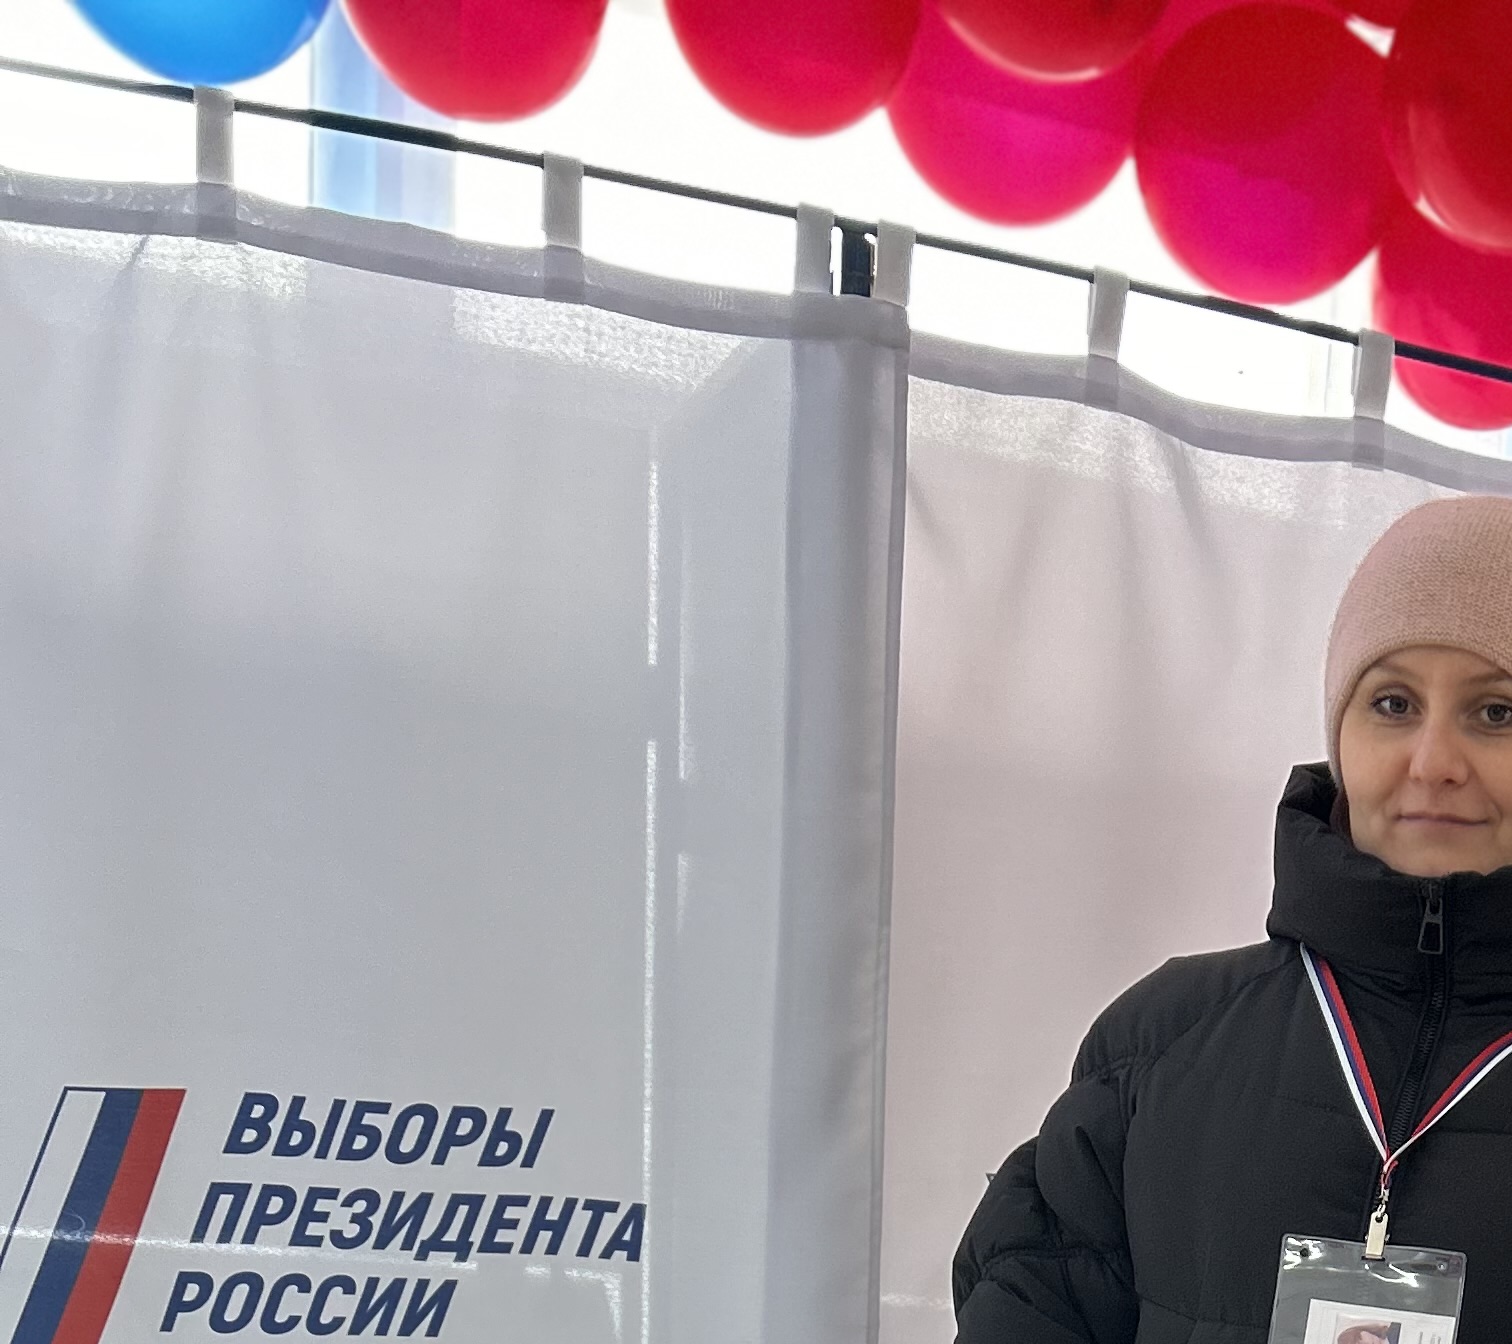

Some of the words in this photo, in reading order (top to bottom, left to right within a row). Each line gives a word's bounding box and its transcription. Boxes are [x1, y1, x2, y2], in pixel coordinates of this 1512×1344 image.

[223, 1092, 555, 1169] ВЫБОРЫ
[190, 1182, 648, 1262] ПРЕЗИДЕНТА
[159, 1271, 458, 1338] РОССИИ
